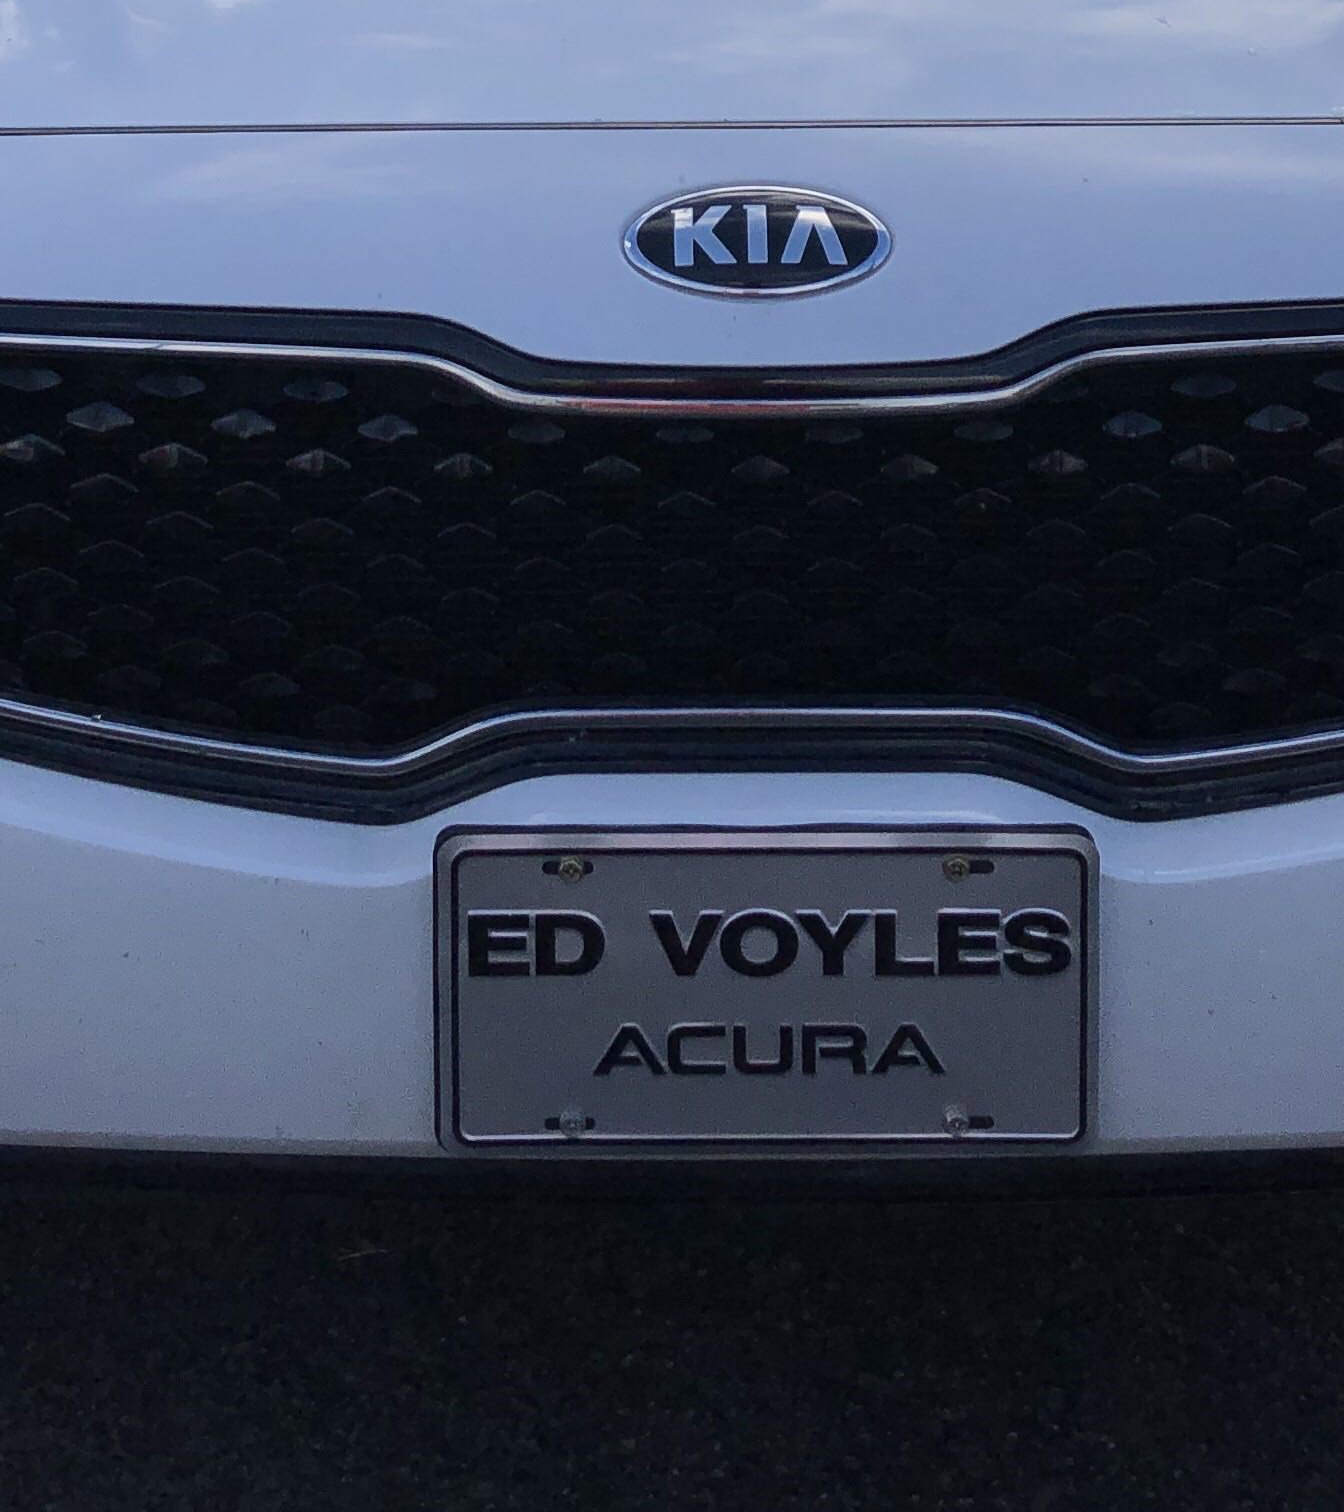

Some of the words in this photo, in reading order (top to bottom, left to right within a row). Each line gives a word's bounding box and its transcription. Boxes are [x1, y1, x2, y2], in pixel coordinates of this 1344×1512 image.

[671, 205, 848, 266] KIA
[467, 909, 605, 976] ED
[650, 908, 1072, 976] VOYLES
[593, 1022, 946, 1075] ACURA
